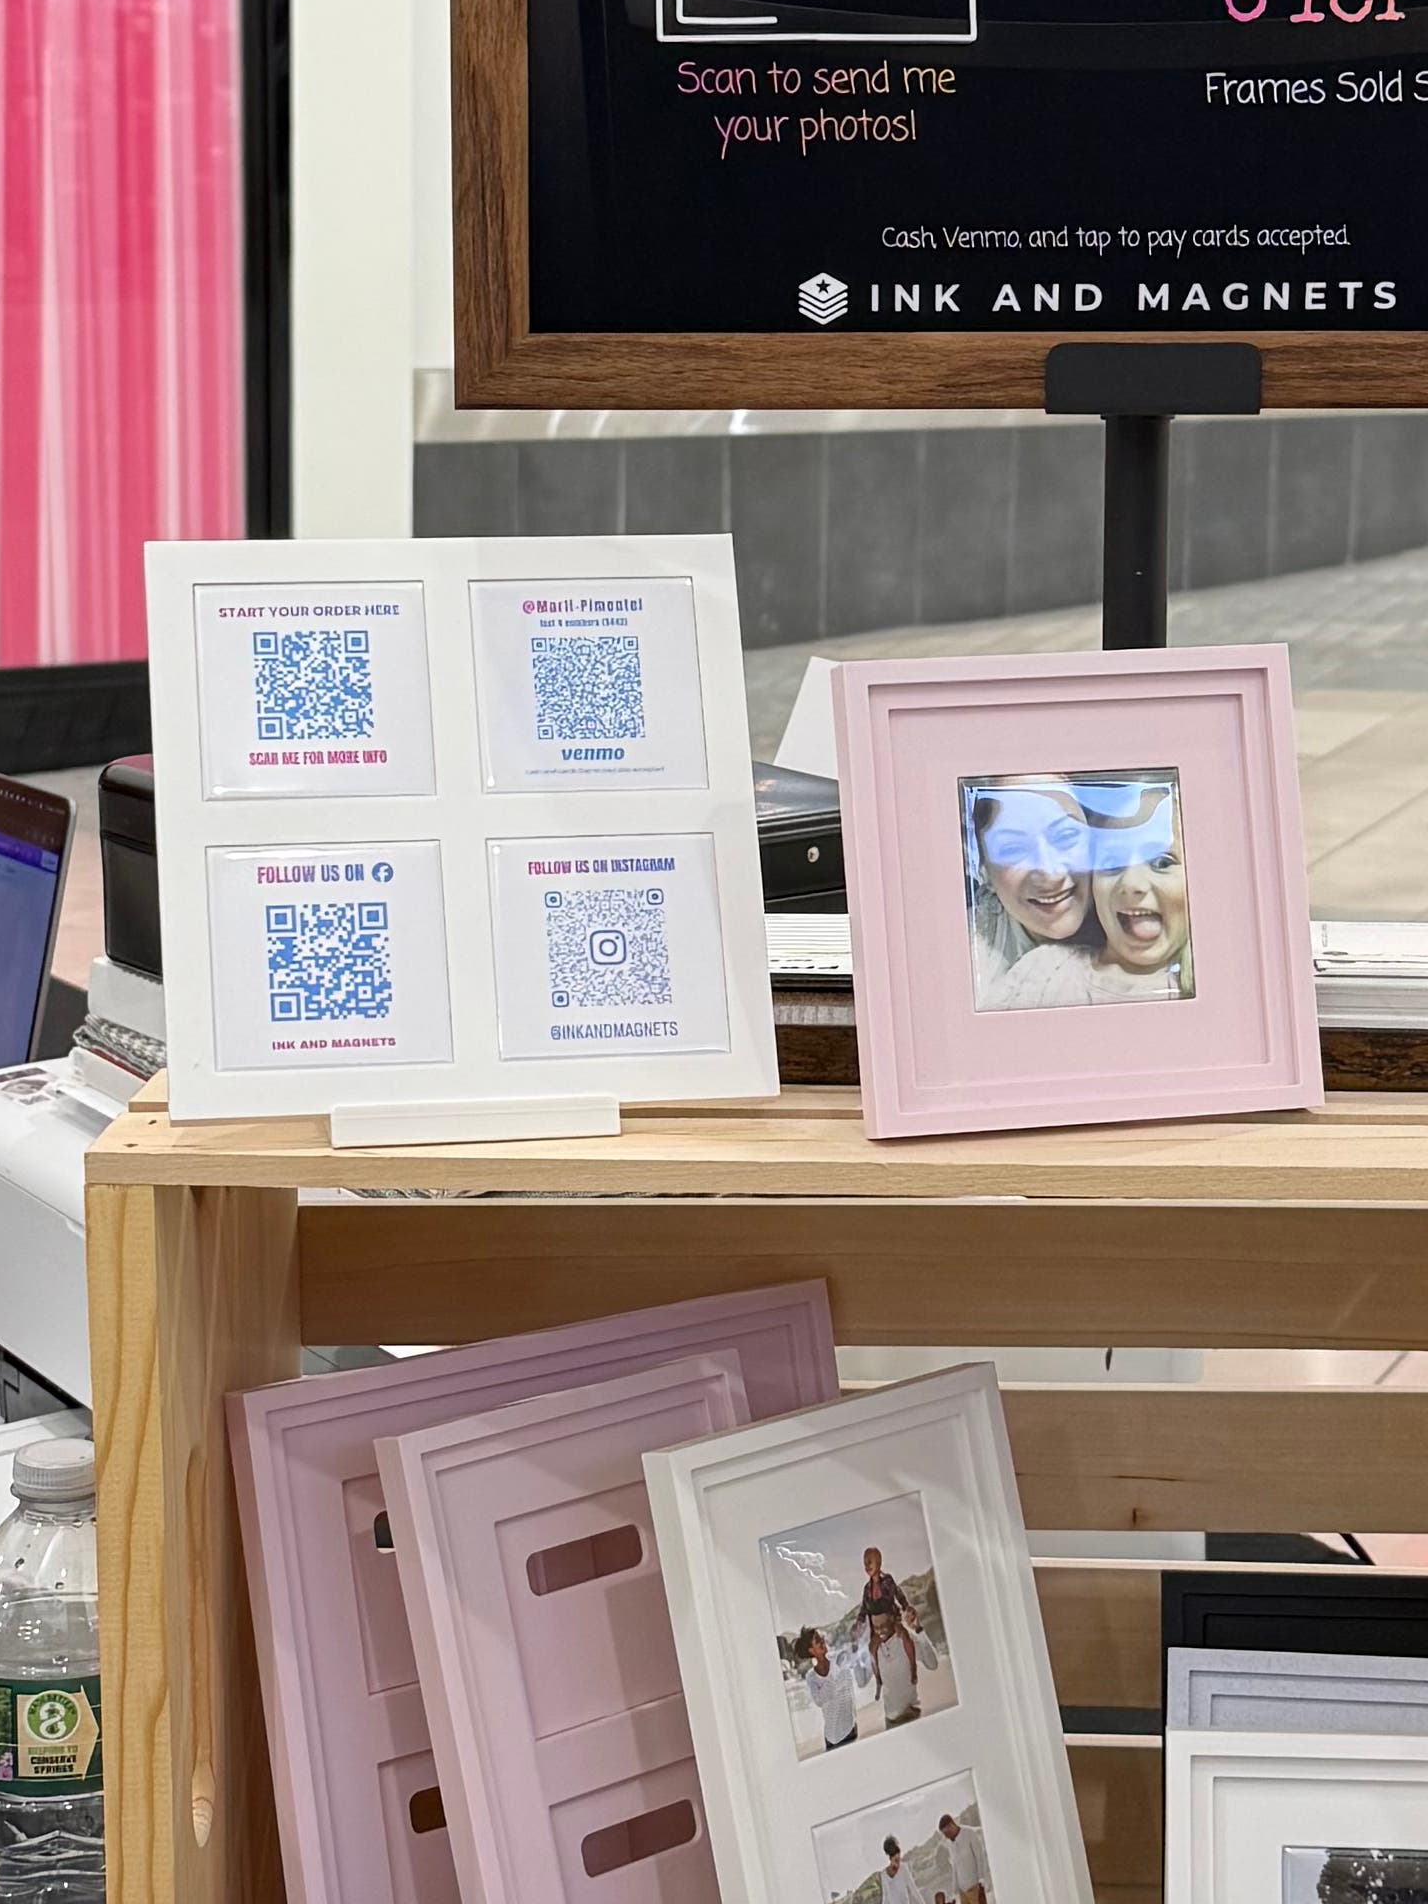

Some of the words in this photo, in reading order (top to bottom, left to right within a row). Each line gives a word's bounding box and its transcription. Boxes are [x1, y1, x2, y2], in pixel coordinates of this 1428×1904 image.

[677, 61, 757, 94] Scan
[767, 61, 802, 94] to
[813, 59, 890, 94] send
[903, 67, 957, 94] me
[1205, 72, 1326, 106] Frames
[1336, 69, 1403, 103] Sold
[714, 114, 790, 160] your
[799, 107, 917, 157] photos!
[1028, 226, 1069, 248] and
[1075, 226, 1112, 256] tap
[1118, 226, 1141, 247] to
[1147, 229, 1188, 259] pay
[1192, 224, 1250, 247] cards
[871, 283, 961, 312] INK
[992, 283, 1104, 312] AND
[1137, 281, 1398, 311] MAGNETS
[218, 606, 266, 618] START
[268, 606, 310, 617] YOUR
[313, 605, 361, 617] ORDER
[364, 604, 400, 616] HERE
[327, 750, 360, 764] MORE
[561, 747, 625, 761] venmo
[257, 864, 315, 884] FOLLOW
[321, 864, 340, 883] US
[345, 864, 364, 882] ON
[528, 860, 571, 875] FOLLOW
[575, 860, 590, 874] US
[593, 859, 608, 873] ON
[611, 857, 675, 872] INSTAGRAM
[550, 1021, 679, 1040] @INKANDMAGNETS
[272, 1041, 295, 1051] INK
[300, 1039, 328, 1050] AND
[331, 1037, 396, 1049] MAGNETS
